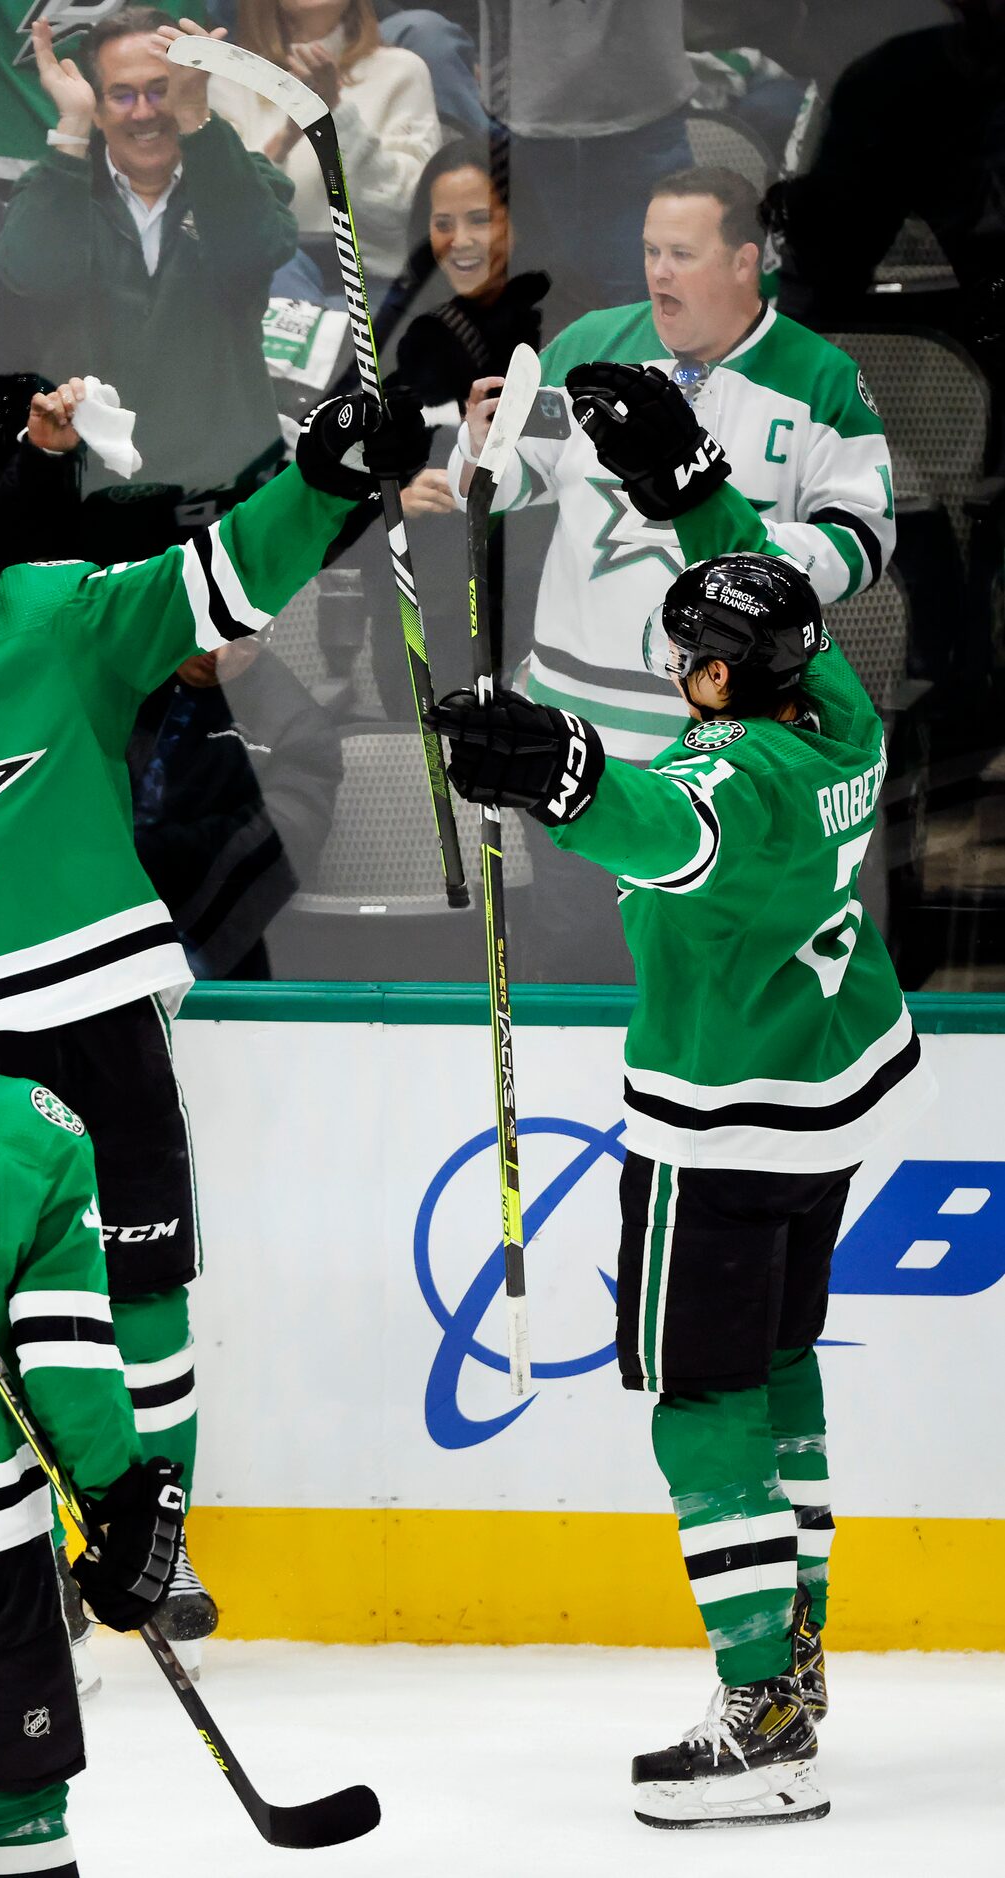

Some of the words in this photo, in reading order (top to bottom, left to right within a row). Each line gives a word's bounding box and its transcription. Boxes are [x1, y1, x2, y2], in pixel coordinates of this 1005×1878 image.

[764, 418, 794, 464] C
[718, 594, 761, 617] TRANSFER
[721, 585, 756, 604] ENERGY
[802, 621, 816, 649] 21
[547, 708, 588, 819] CCM
[497, 936, 508, 1005] SUPER
[198, 1728, 229, 1772] CCM
